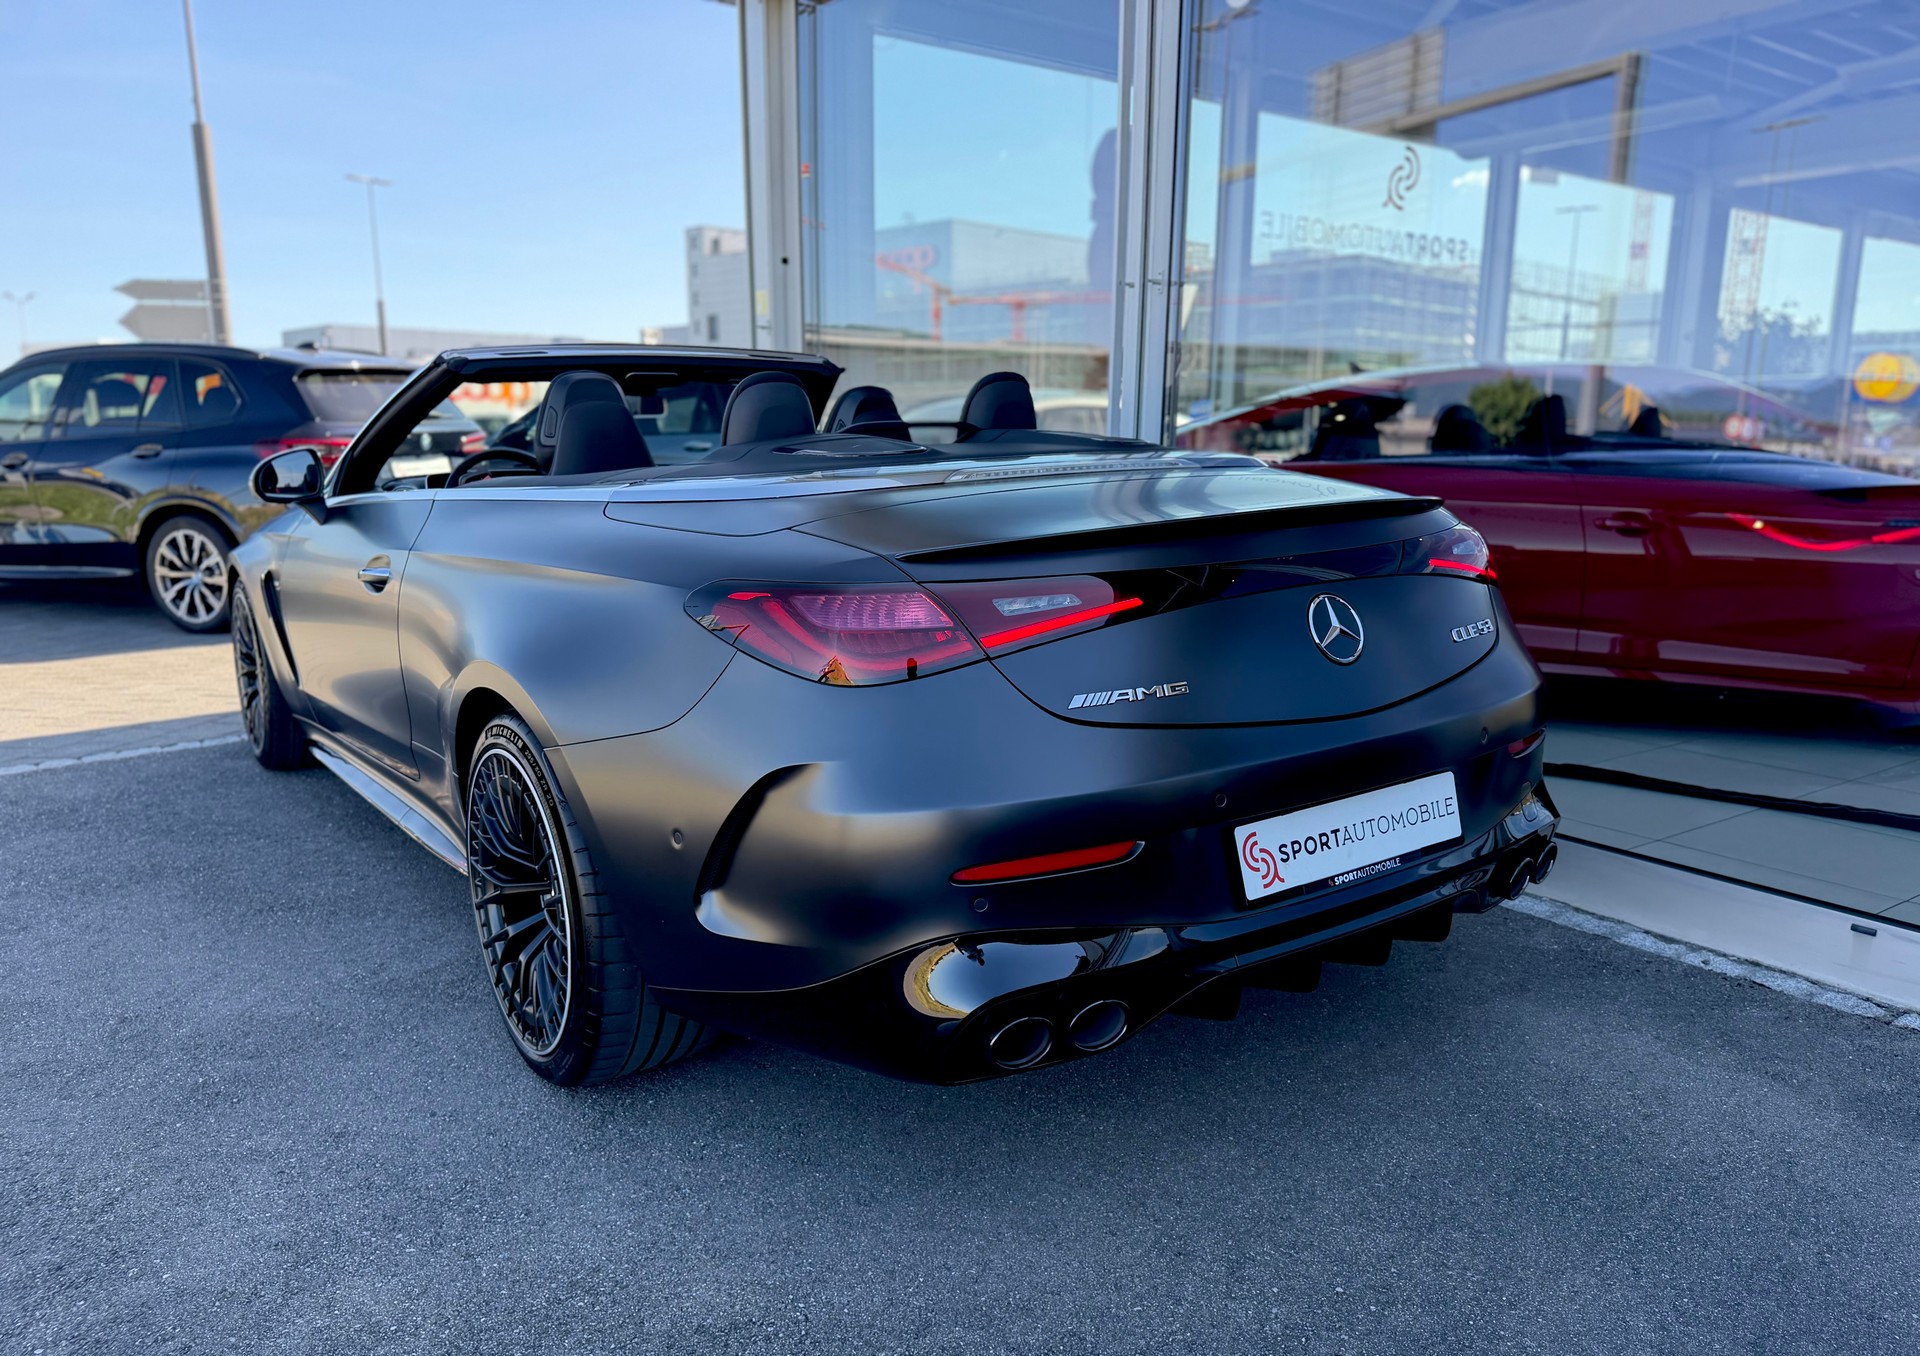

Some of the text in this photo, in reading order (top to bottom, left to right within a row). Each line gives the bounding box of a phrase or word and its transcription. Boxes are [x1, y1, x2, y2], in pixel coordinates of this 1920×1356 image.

[1108, 681, 1190, 705] AMG
[492, 726, 523, 749] MICHELIN
[1278, 796, 1456, 863] SPORTAUTOMOBILE
[1334, 857, 1402, 886] SPORTAUTOMOBILE
